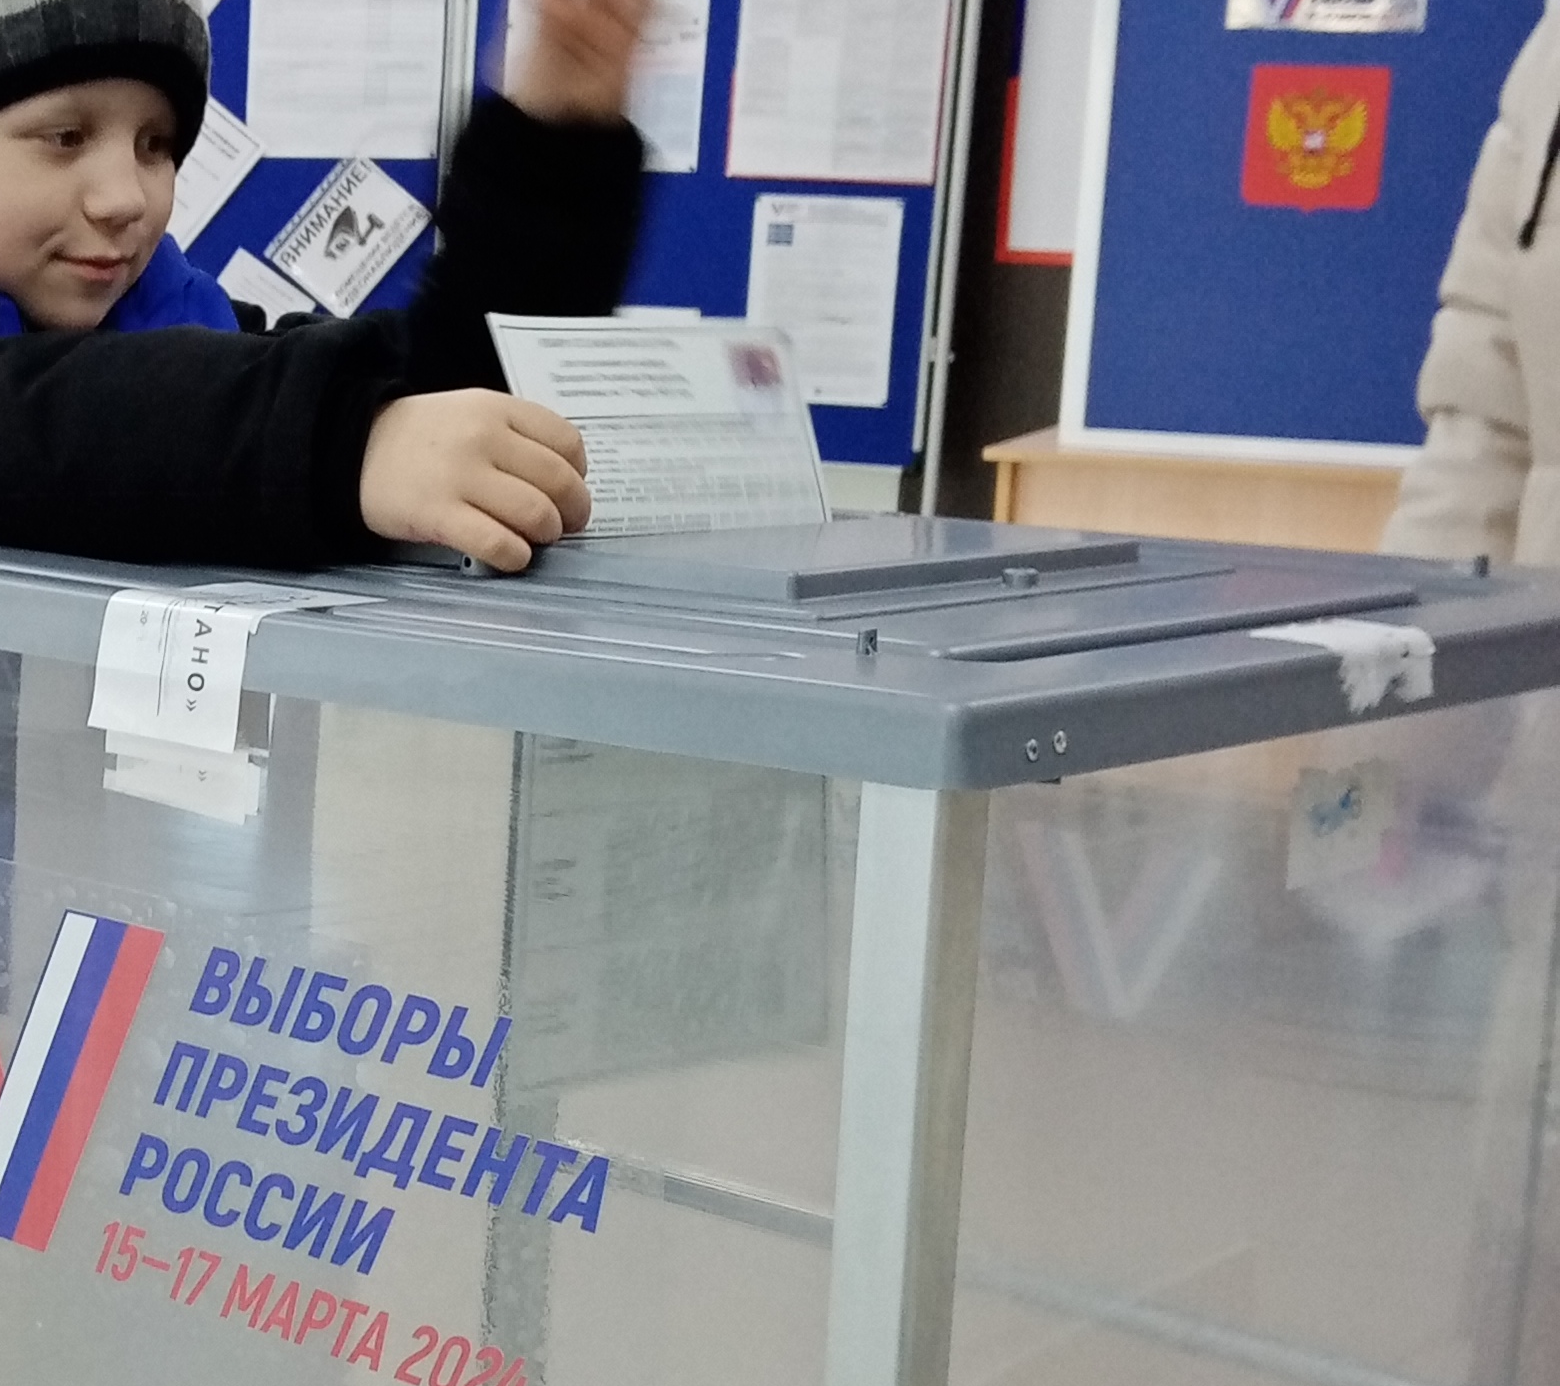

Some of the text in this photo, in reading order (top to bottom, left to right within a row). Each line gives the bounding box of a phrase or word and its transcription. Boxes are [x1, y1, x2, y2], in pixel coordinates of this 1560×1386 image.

[189, 946, 512, 1088] ВЫБОРЫ
[119, 1132, 395, 1276] РОССИИ
[153, 1040, 610, 1234] ПРЕЗИДЕНТА
[220, 1263, 390, 1372] МАРТА
